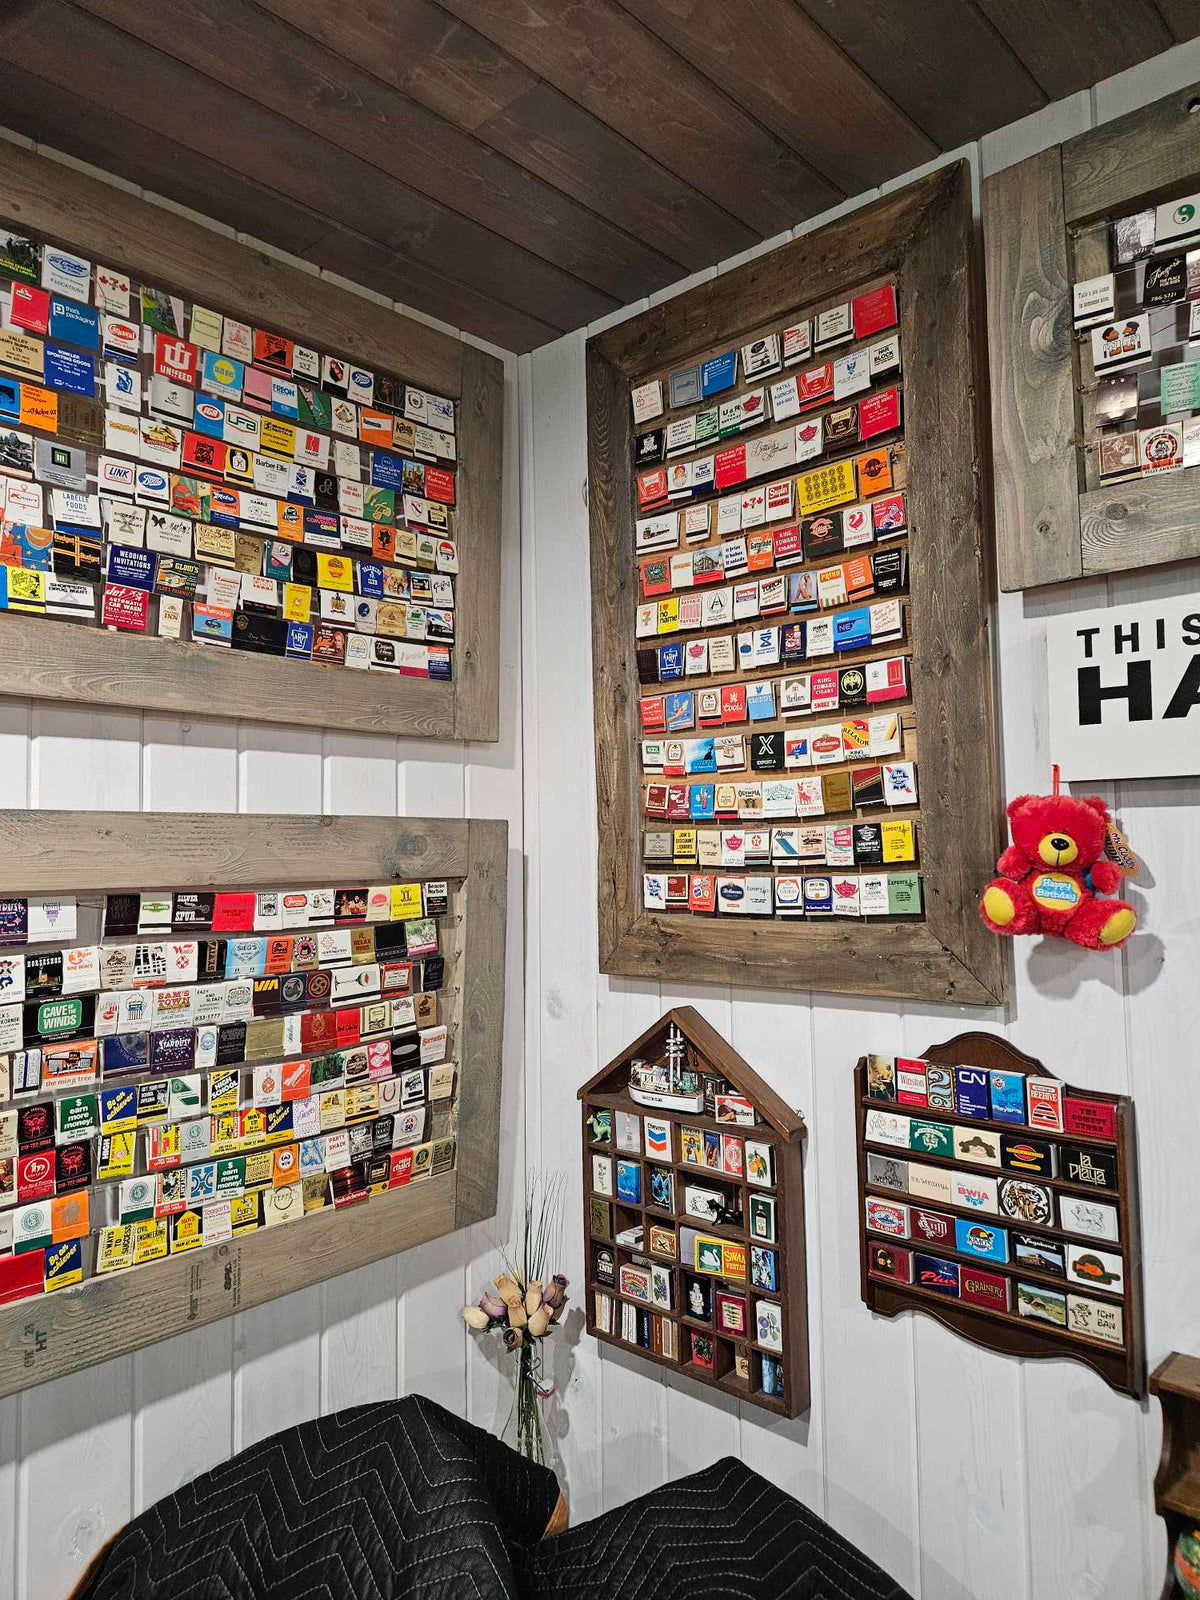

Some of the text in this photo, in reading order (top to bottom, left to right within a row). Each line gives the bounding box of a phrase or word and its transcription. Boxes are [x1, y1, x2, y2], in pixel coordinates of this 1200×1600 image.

[160, 364, 192, 383] UNIFEED
[109, 467, 130, 479] LINK
[66, 501, 87, 511] FOODS
[54, 533, 75, 545] Budget
[80, 553, 100, 564] Budget
[120, 550, 147, 561] WEDDING
[114, 557, 151, 569] INVITATIONS
[660, 615, 678, 624] name
[1077, 613, 1200, 658] THIS
[43, 1004, 67, 1017] CAVE
[43, 1015, 77, 1029] WINDS
[900, 1074, 925, 1088] Winston
[959, 1070, 986, 1086] CN
[69, 1105, 88, 1114] earn
[64, 1117, 93, 1130] money!
[68, 1113, 89, 1122] more
[101, 1138, 110, 1160] HIGH
[222, 1168, 238, 1176] earn
[957, 1186, 989, 1201] BWIA
[122, 1224, 132, 1255] SUCCESS
[964, 1279, 1004, 1298] GRAINERY
